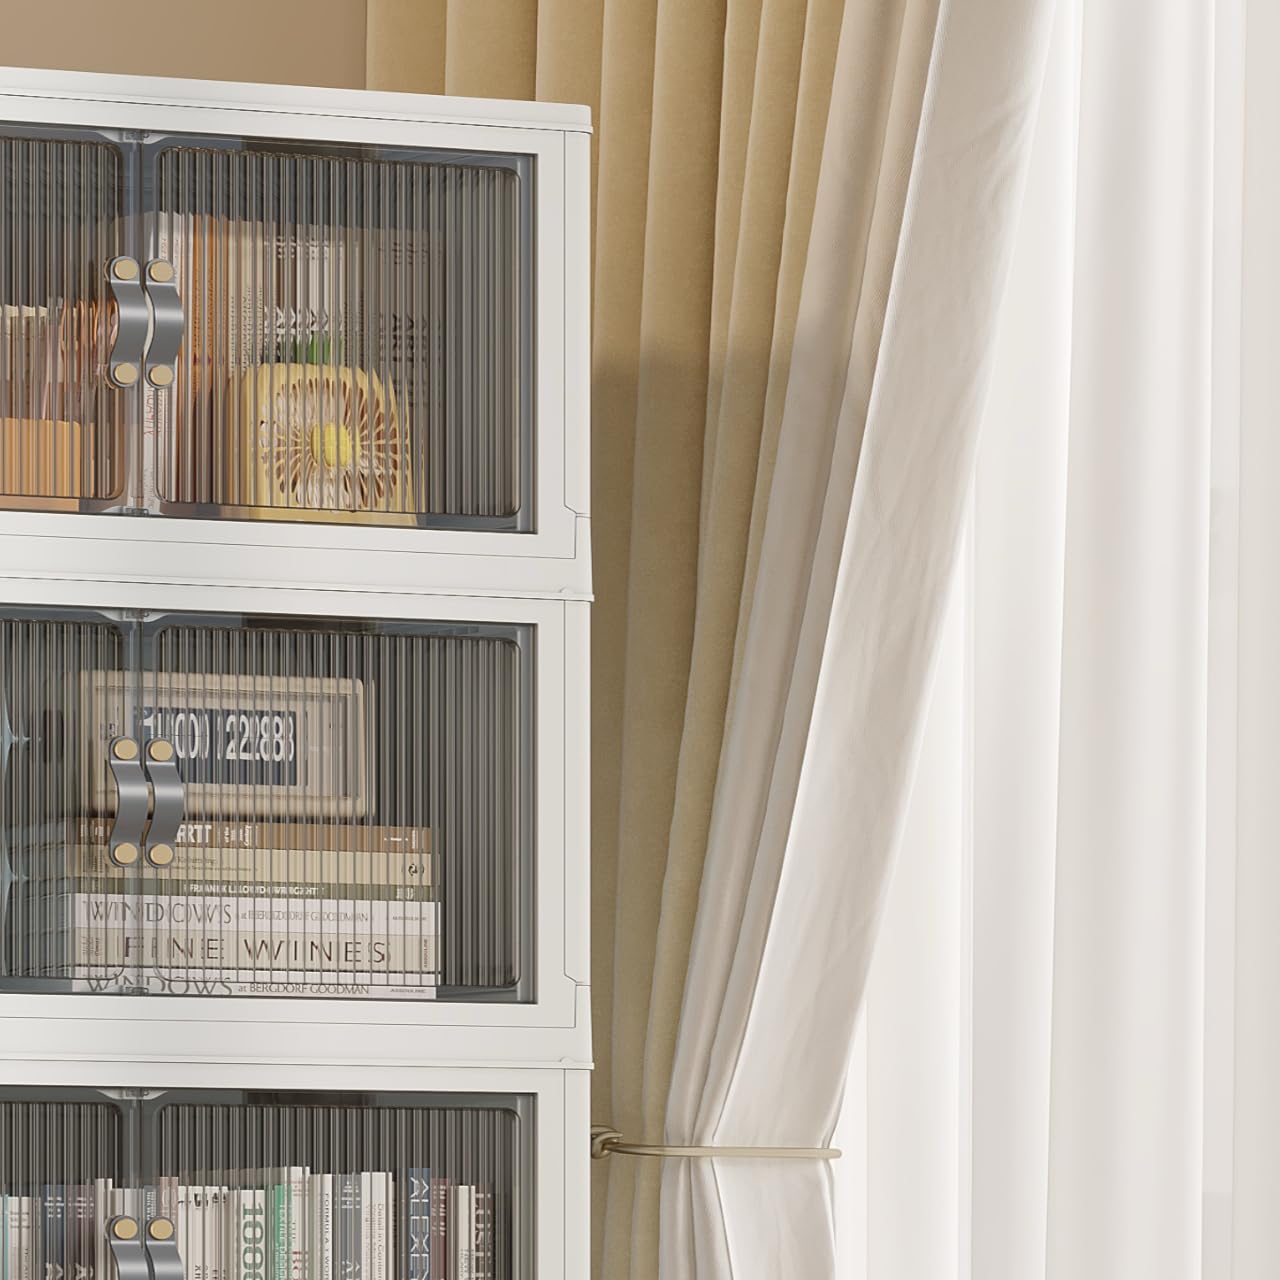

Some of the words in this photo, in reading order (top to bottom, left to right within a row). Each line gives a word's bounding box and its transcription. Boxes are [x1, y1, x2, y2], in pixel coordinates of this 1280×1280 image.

[86, 901, 233, 924] WINDOWS
[124, 936, 224, 960] FINE
[243, 939, 389, 964] WINES
[238, 984, 248, 993] at
[249, 983, 308, 994] BERGDORF
[309, 984, 369, 995] GOODMAN
